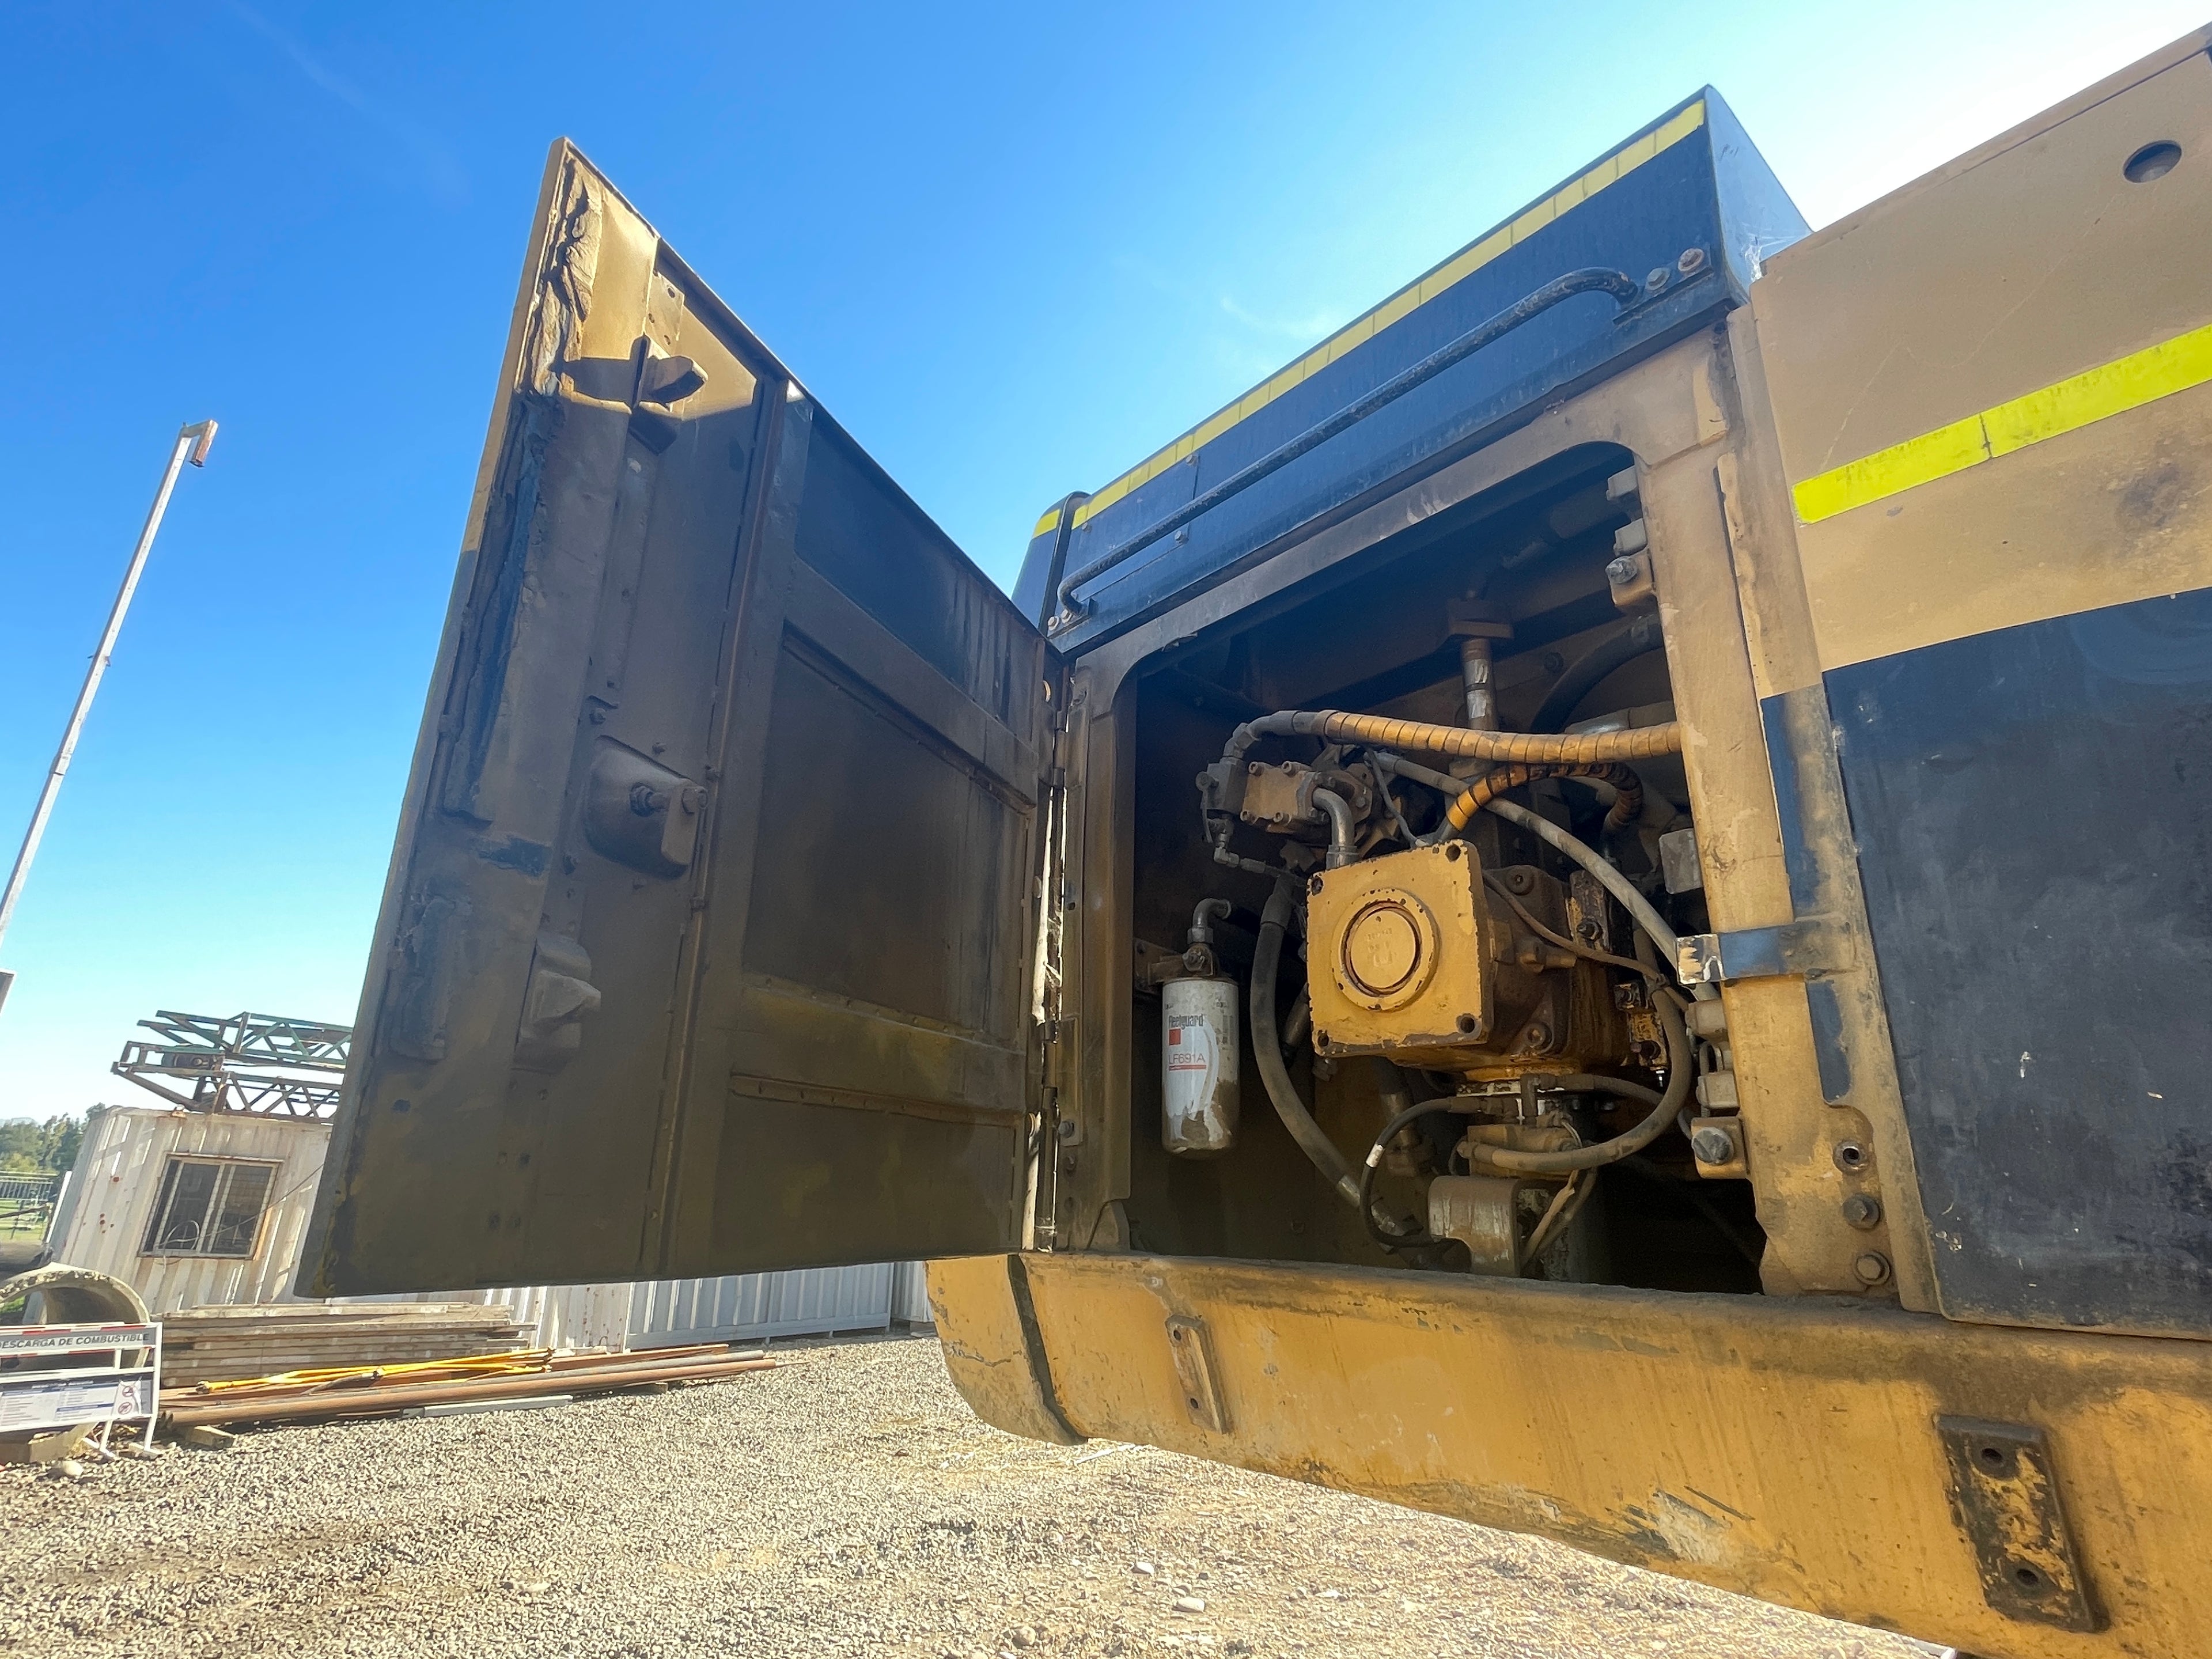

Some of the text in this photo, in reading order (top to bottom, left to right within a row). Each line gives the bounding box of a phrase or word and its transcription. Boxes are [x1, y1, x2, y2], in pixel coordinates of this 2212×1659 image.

[1168, 1053, 1206, 1065] LF691A
[0, 1333, 150, 1349] ESCARGA DE COMBUSTIBLE
